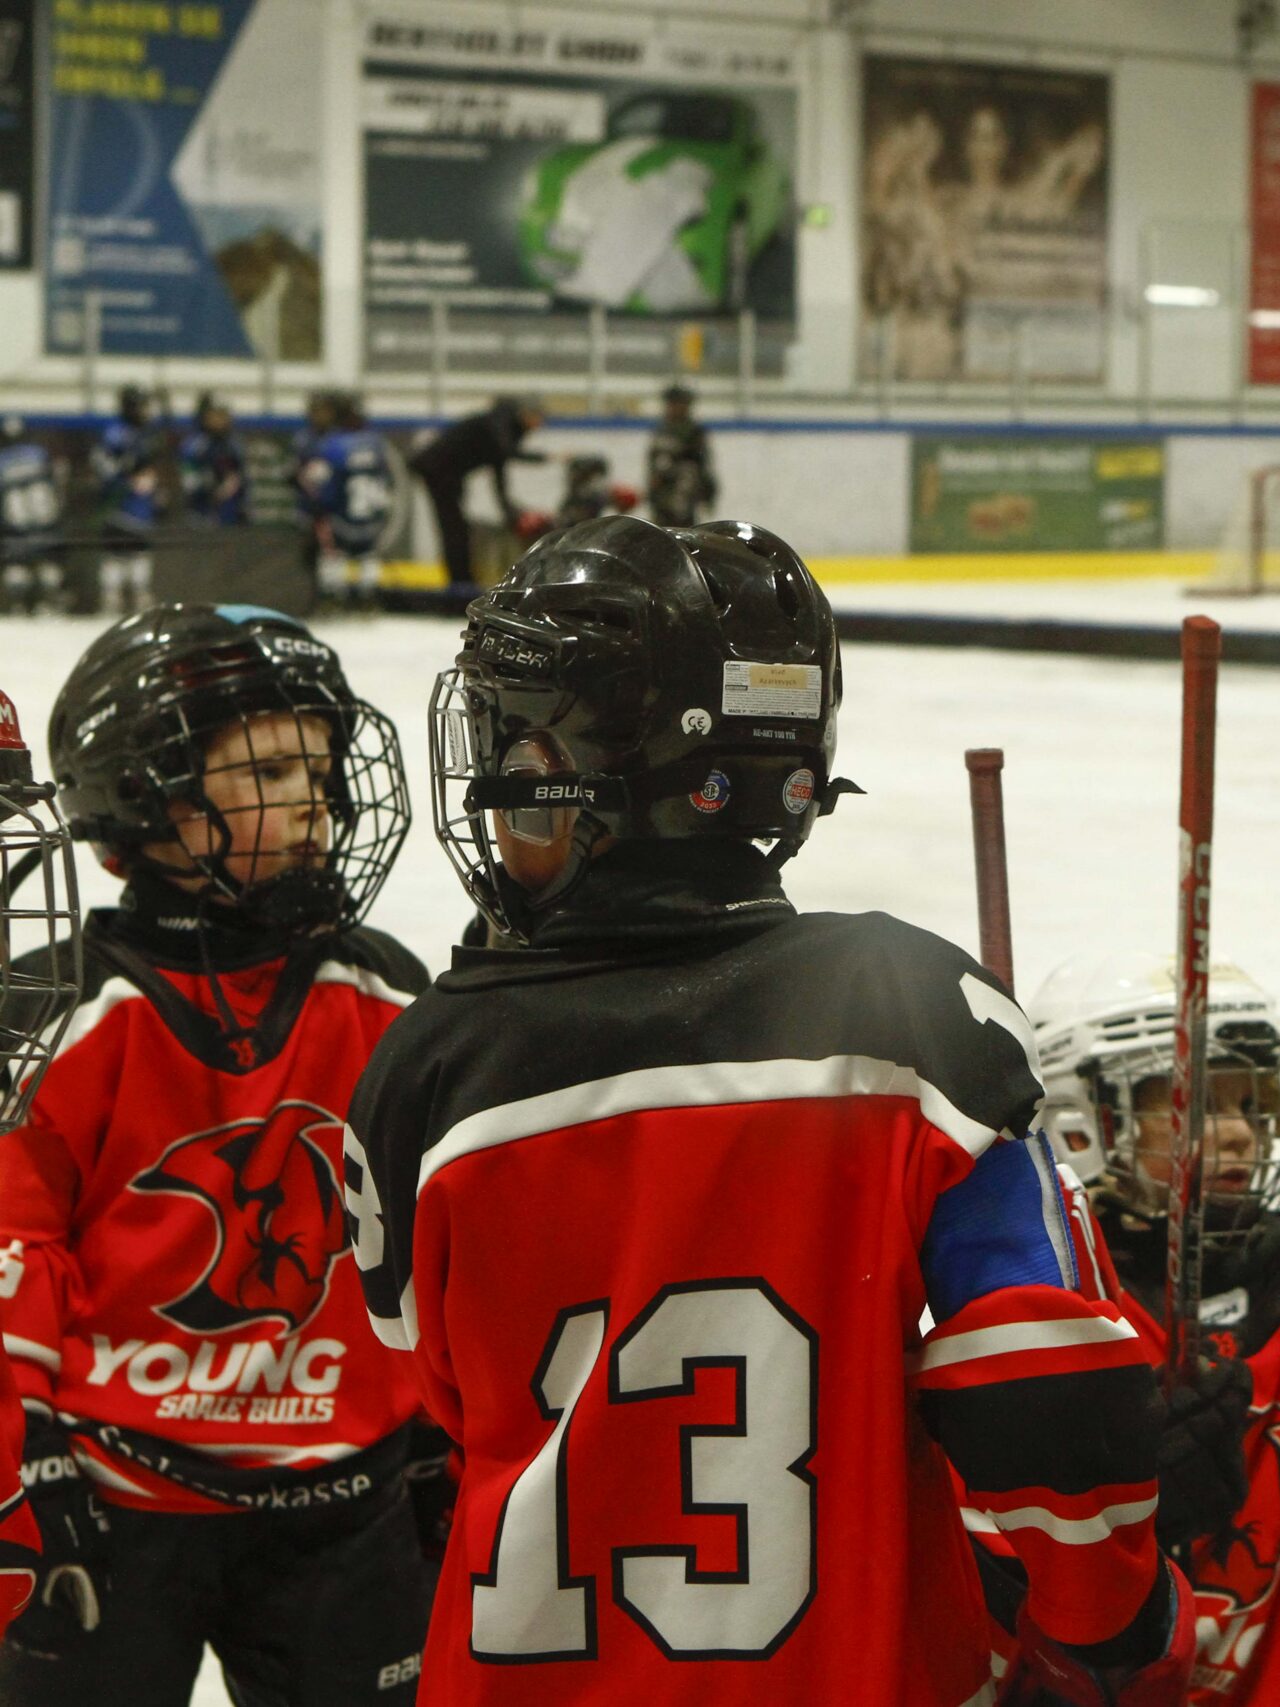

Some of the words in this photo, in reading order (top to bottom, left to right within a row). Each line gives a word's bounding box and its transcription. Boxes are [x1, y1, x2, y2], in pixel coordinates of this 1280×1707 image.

[273, 636, 330, 661] CCM
[86, 1333, 348, 1397] YOUNG
[155, 1394, 245, 1422] SAALE
[247, 1395, 336, 1424] BULLS
[470, 1276, 821, 1665] 13
